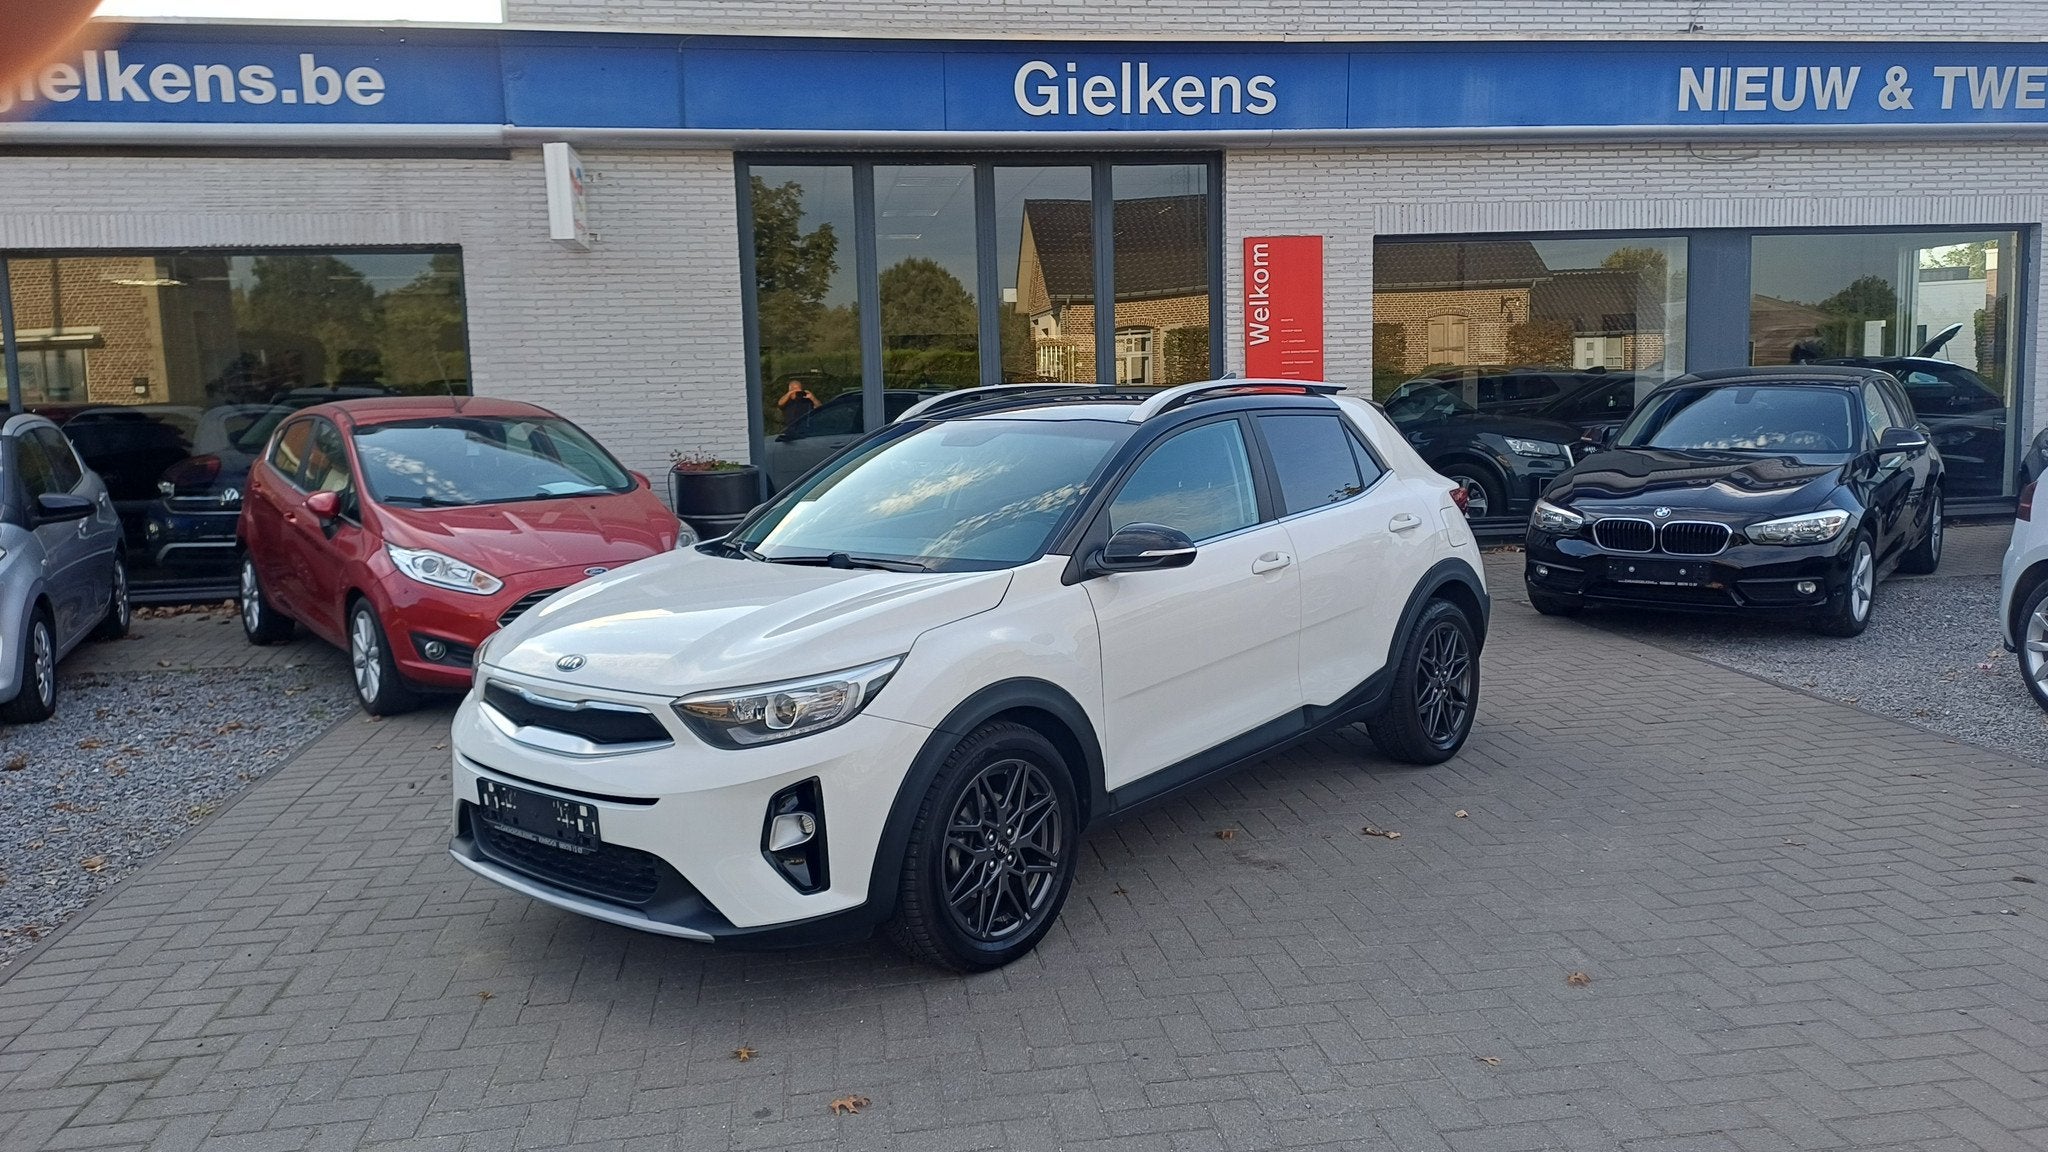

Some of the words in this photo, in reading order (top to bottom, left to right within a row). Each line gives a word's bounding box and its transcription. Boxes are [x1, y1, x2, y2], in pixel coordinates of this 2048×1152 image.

[0, 50, 386, 113] elkens.be
[1014, 60, 1277, 116] Gielkens
[1677, 66, 1861, 112] NIEUW
[1878, 65, 1914, 111] &
[1933, 66, 2048, 110] TWE
[1249, 242, 1270, 346] Welkom
[557, 656, 582, 669] KIA
